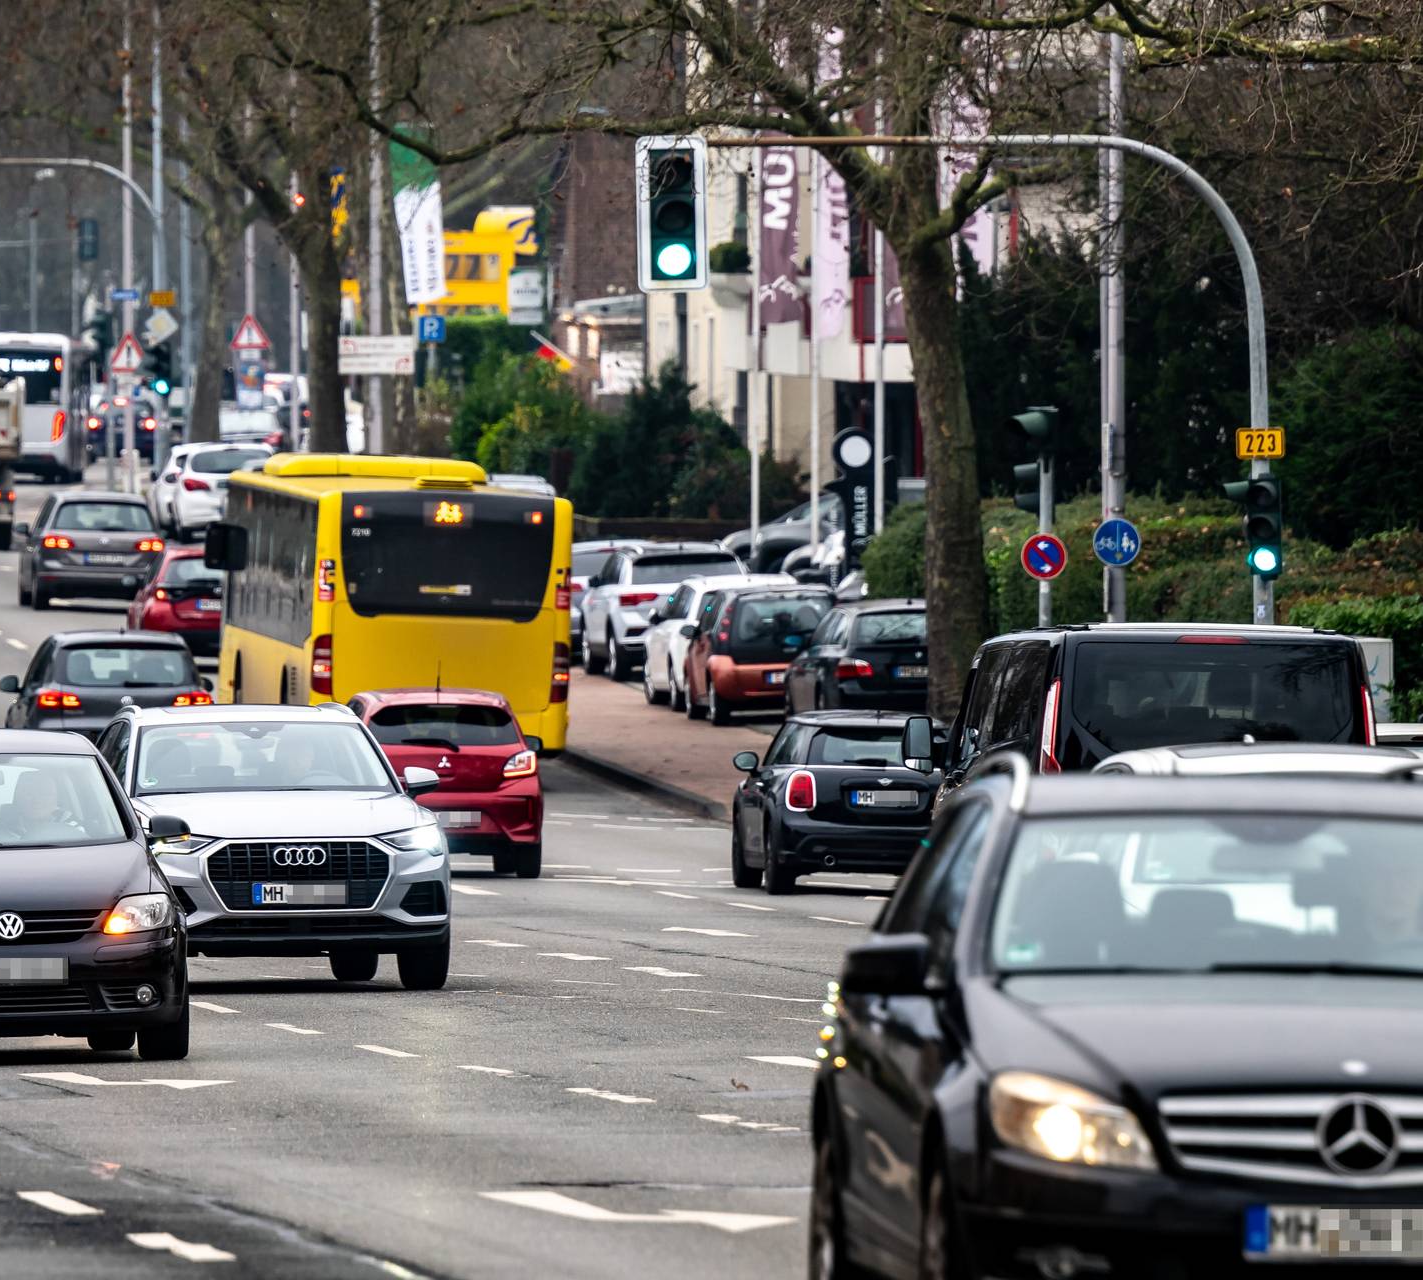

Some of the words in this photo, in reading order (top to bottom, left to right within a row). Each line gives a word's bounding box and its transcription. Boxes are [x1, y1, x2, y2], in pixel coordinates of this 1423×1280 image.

[1245, 433, 1276, 453] 223
[858, 791, 873, 803] MH
[263, 886, 283, 901] MH
[1269, 1215, 1318, 1247] MH
